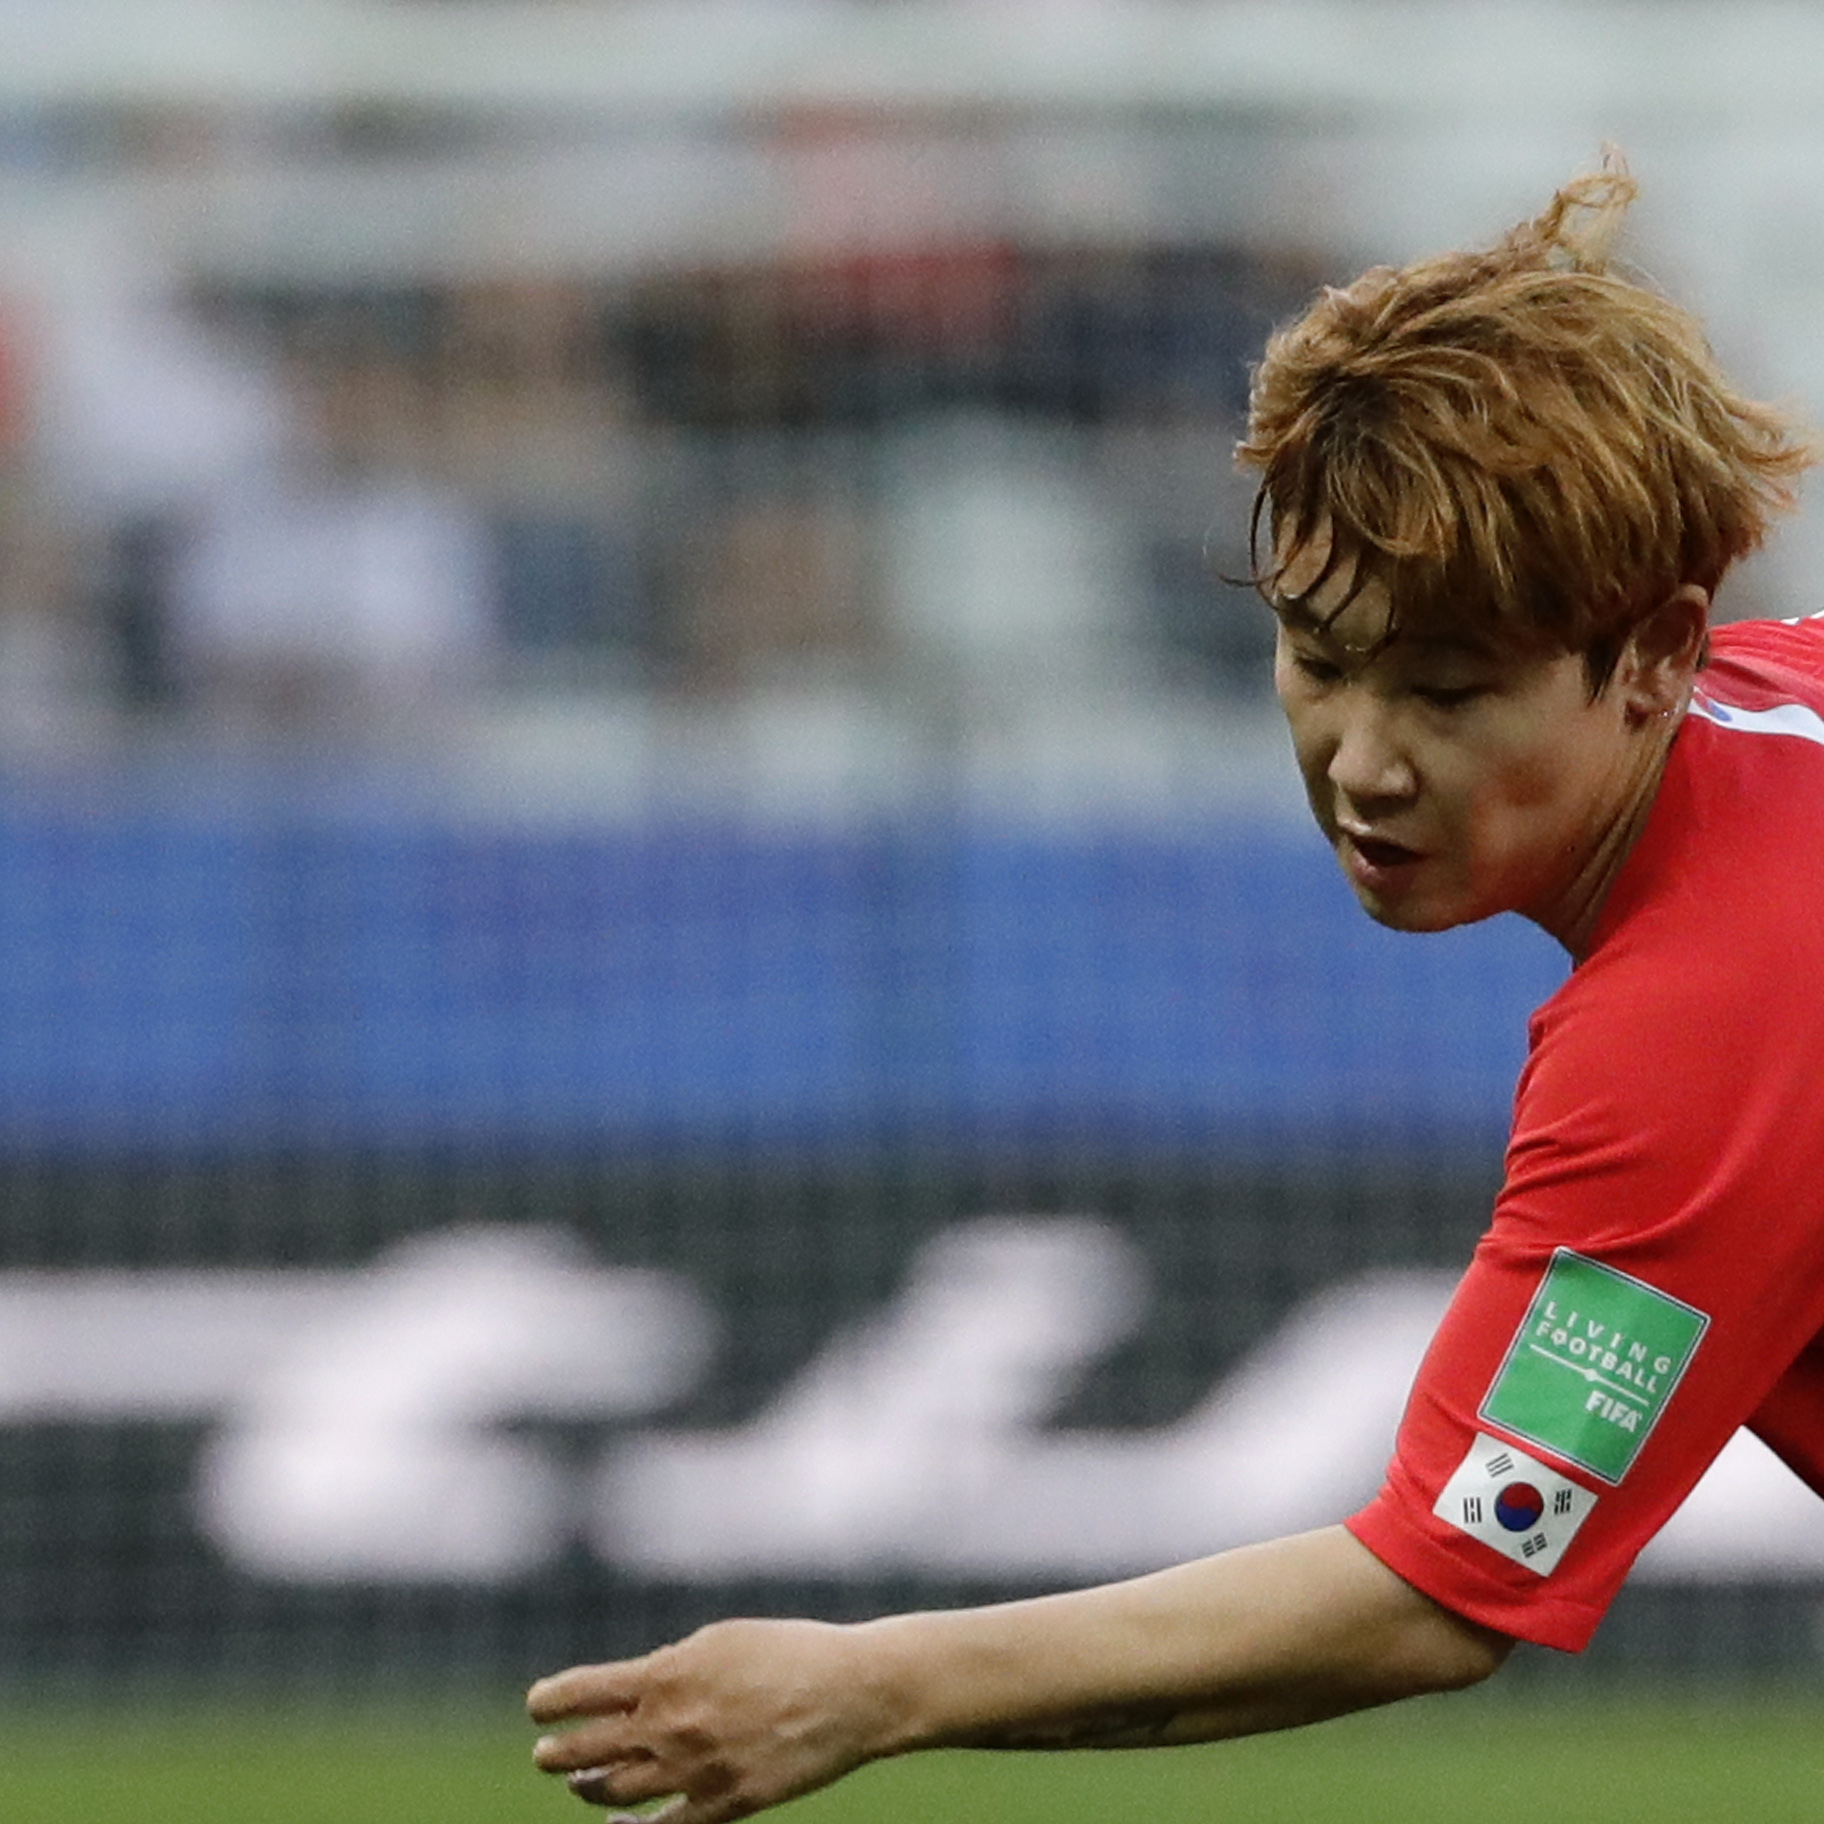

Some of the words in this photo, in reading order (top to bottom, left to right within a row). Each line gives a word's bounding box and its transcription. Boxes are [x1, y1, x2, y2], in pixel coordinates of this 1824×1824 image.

[1535, 1320, 1659, 1394] FOOTBALL
[1543, 1300, 1673, 1375] LIVING
[1585, 1389, 1644, 1434] FIFA
